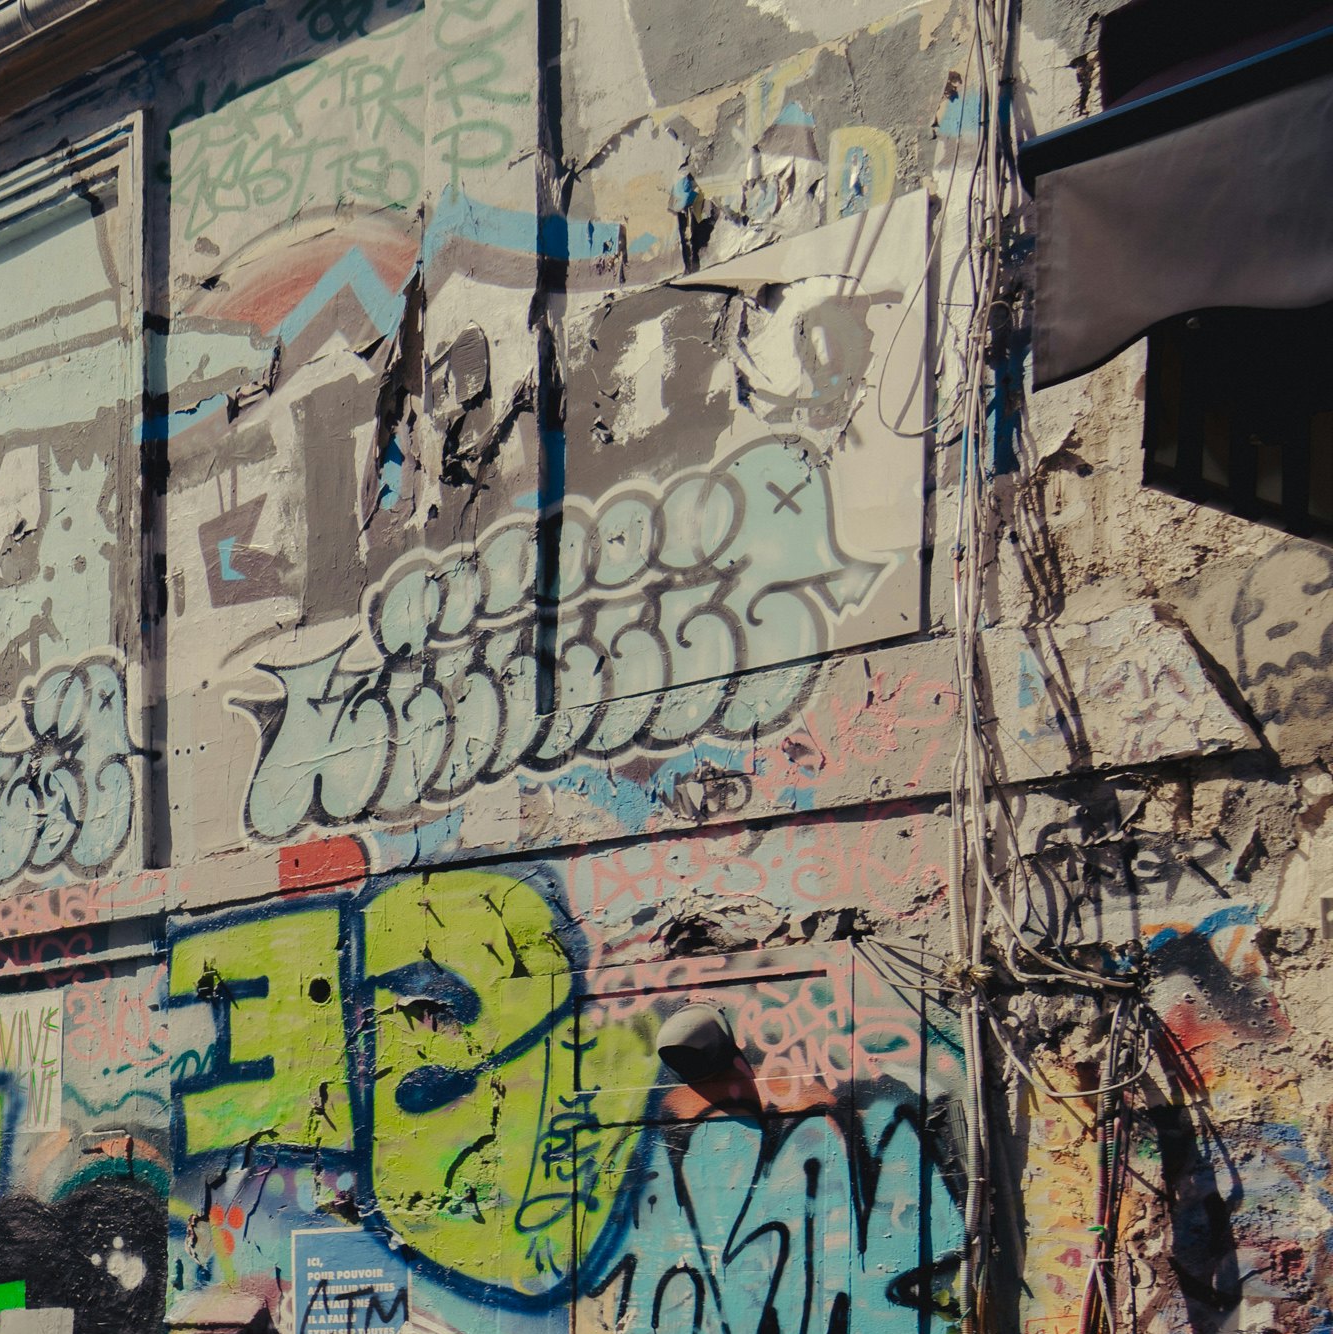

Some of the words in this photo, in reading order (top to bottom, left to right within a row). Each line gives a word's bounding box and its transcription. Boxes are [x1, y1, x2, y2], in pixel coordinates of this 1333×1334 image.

[307, 1257, 324, 1268] ICI,
[307, 1271, 335, 1281] POUR
[337, 1269, 384, 1279] POUVOIR
[307, 1315, 317, 1324] IL
[318, 1314, 326, 1324] A
